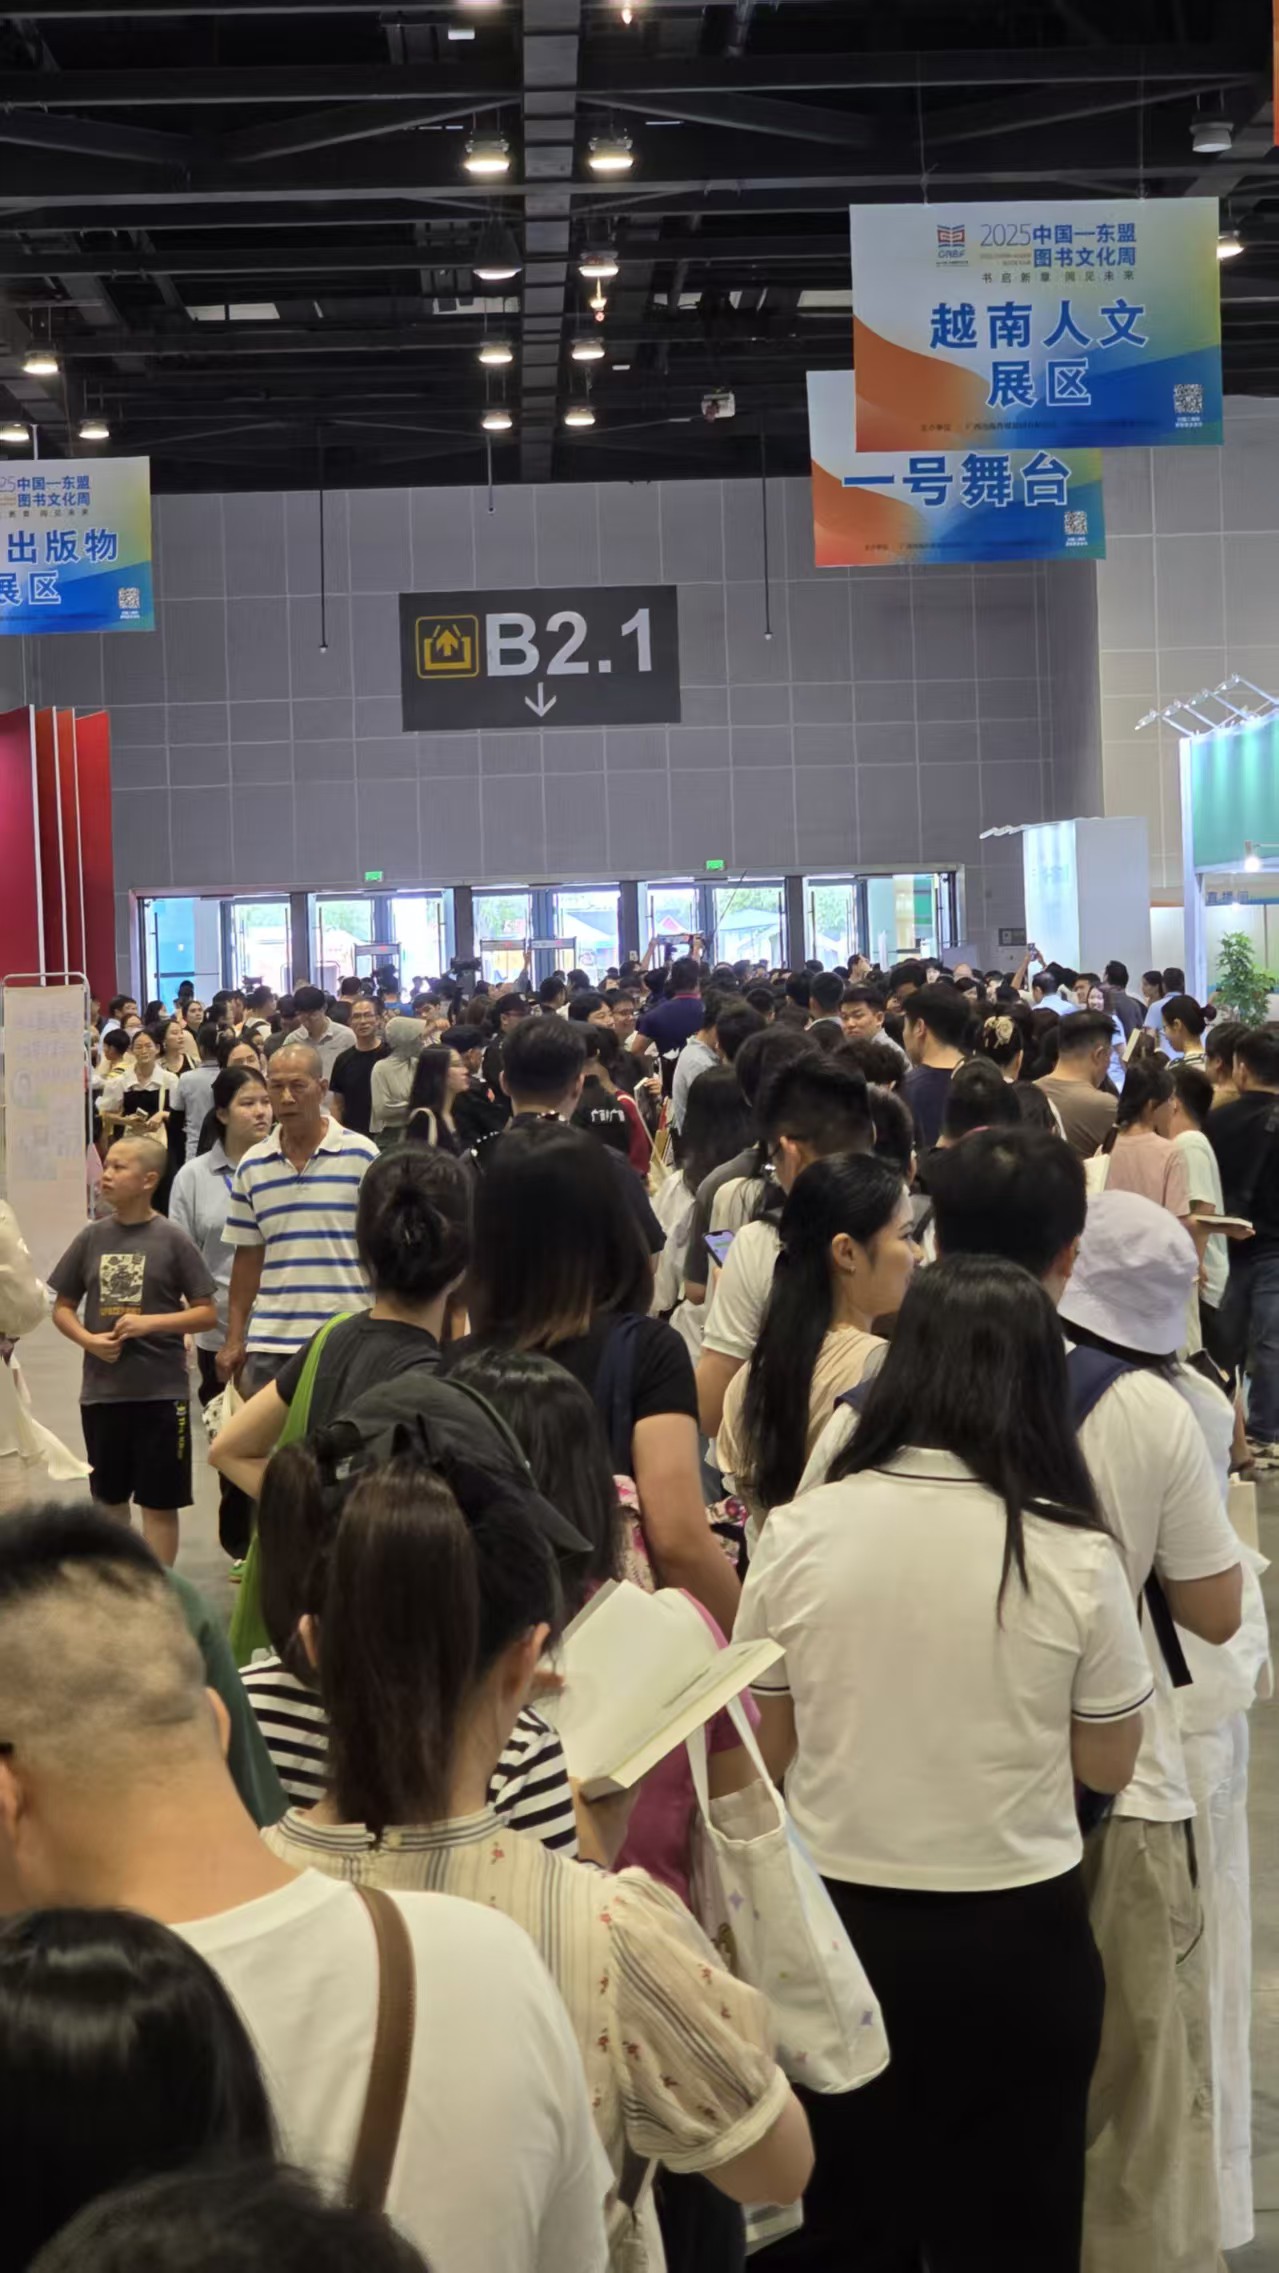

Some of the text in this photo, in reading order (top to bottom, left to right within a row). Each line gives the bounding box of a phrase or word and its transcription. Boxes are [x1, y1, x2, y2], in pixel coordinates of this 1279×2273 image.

[1033, 247, 1136, 268] 图书文化周
[930, 298, 1148, 350] 越南人文
[986, 358, 1092, 409] 展区
[18, 492, 91, 508] 图书文化周
[842, 450, 1072, 509] 一号舞台
[7, 526, 119, 564] 出版物
[0, 570, 61, 607] 展区
[485, 607, 652, 677] B2.1
